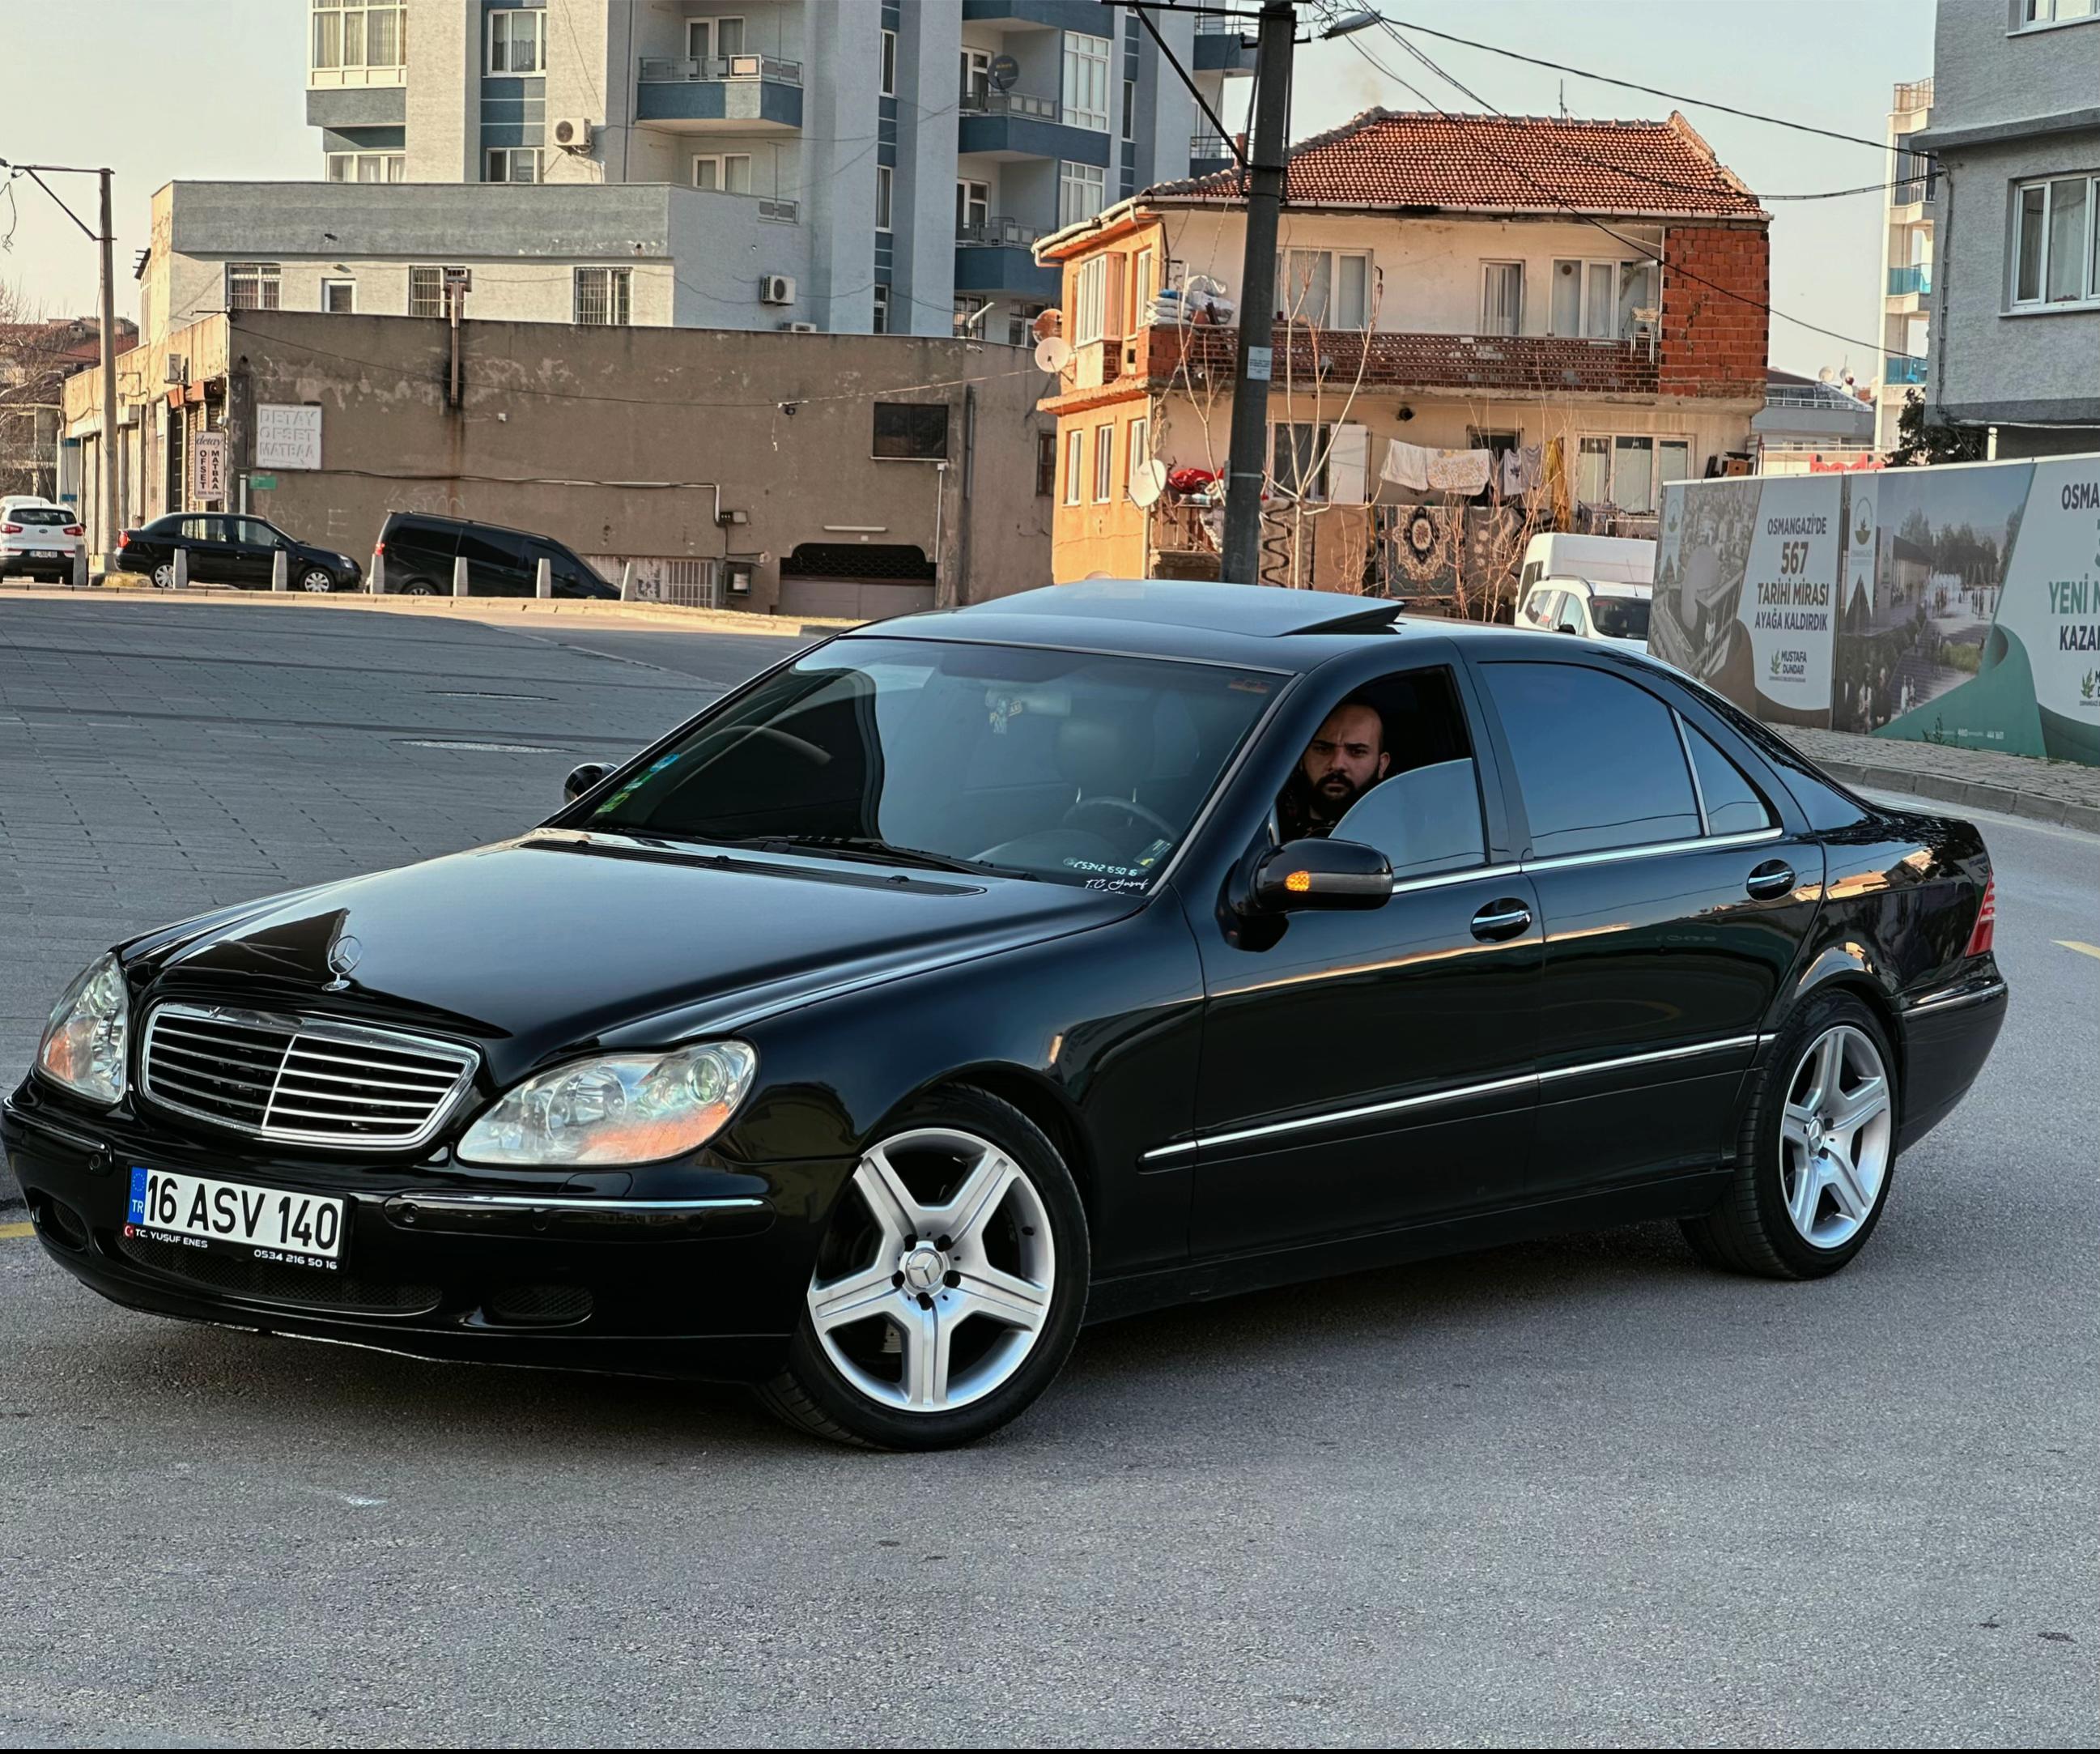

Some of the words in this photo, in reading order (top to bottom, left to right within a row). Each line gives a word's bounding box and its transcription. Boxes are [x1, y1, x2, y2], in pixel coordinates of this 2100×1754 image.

[259, 408, 317, 426] DETAY
[196, 435, 224, 449] detay
[259, 426, 316, 441] OFSET
[259, 441, 315, 458] MATBAA
[199, 449, 207, 489] OFSET
[210, 449, 220, 490] MATBAA
[1767, 513, 1827, 535] OSMANGAZİ'DE
[1781, 541, 1809, 575] 567
[1758, 577, 1792, 605] TARİHİ
[1792, 577, 1830, 607] MİRASI
[2048, 573, 2089, 615] YENİ
[1754, 608, 1783, 629] AYAĞA
[1784, 612, 1828, 631] KALDIRDIK
[1781, 650, 1807, 663] MUSTAFA
[132, 1198, 143, 1214] TR
[147, 1175, 179, 1224] 16
[186, 1183, 266, 1238] ASV
[278, 1196, 338, 1250] 140
[183, 1237, 208, 1249] ENES
[253, 1250, 283, 1261] 0534
[286, 1254, 305, 1265] 216
[308, 1258, 323, 1267] 50
[325, 1260, 338, 1270] 16
